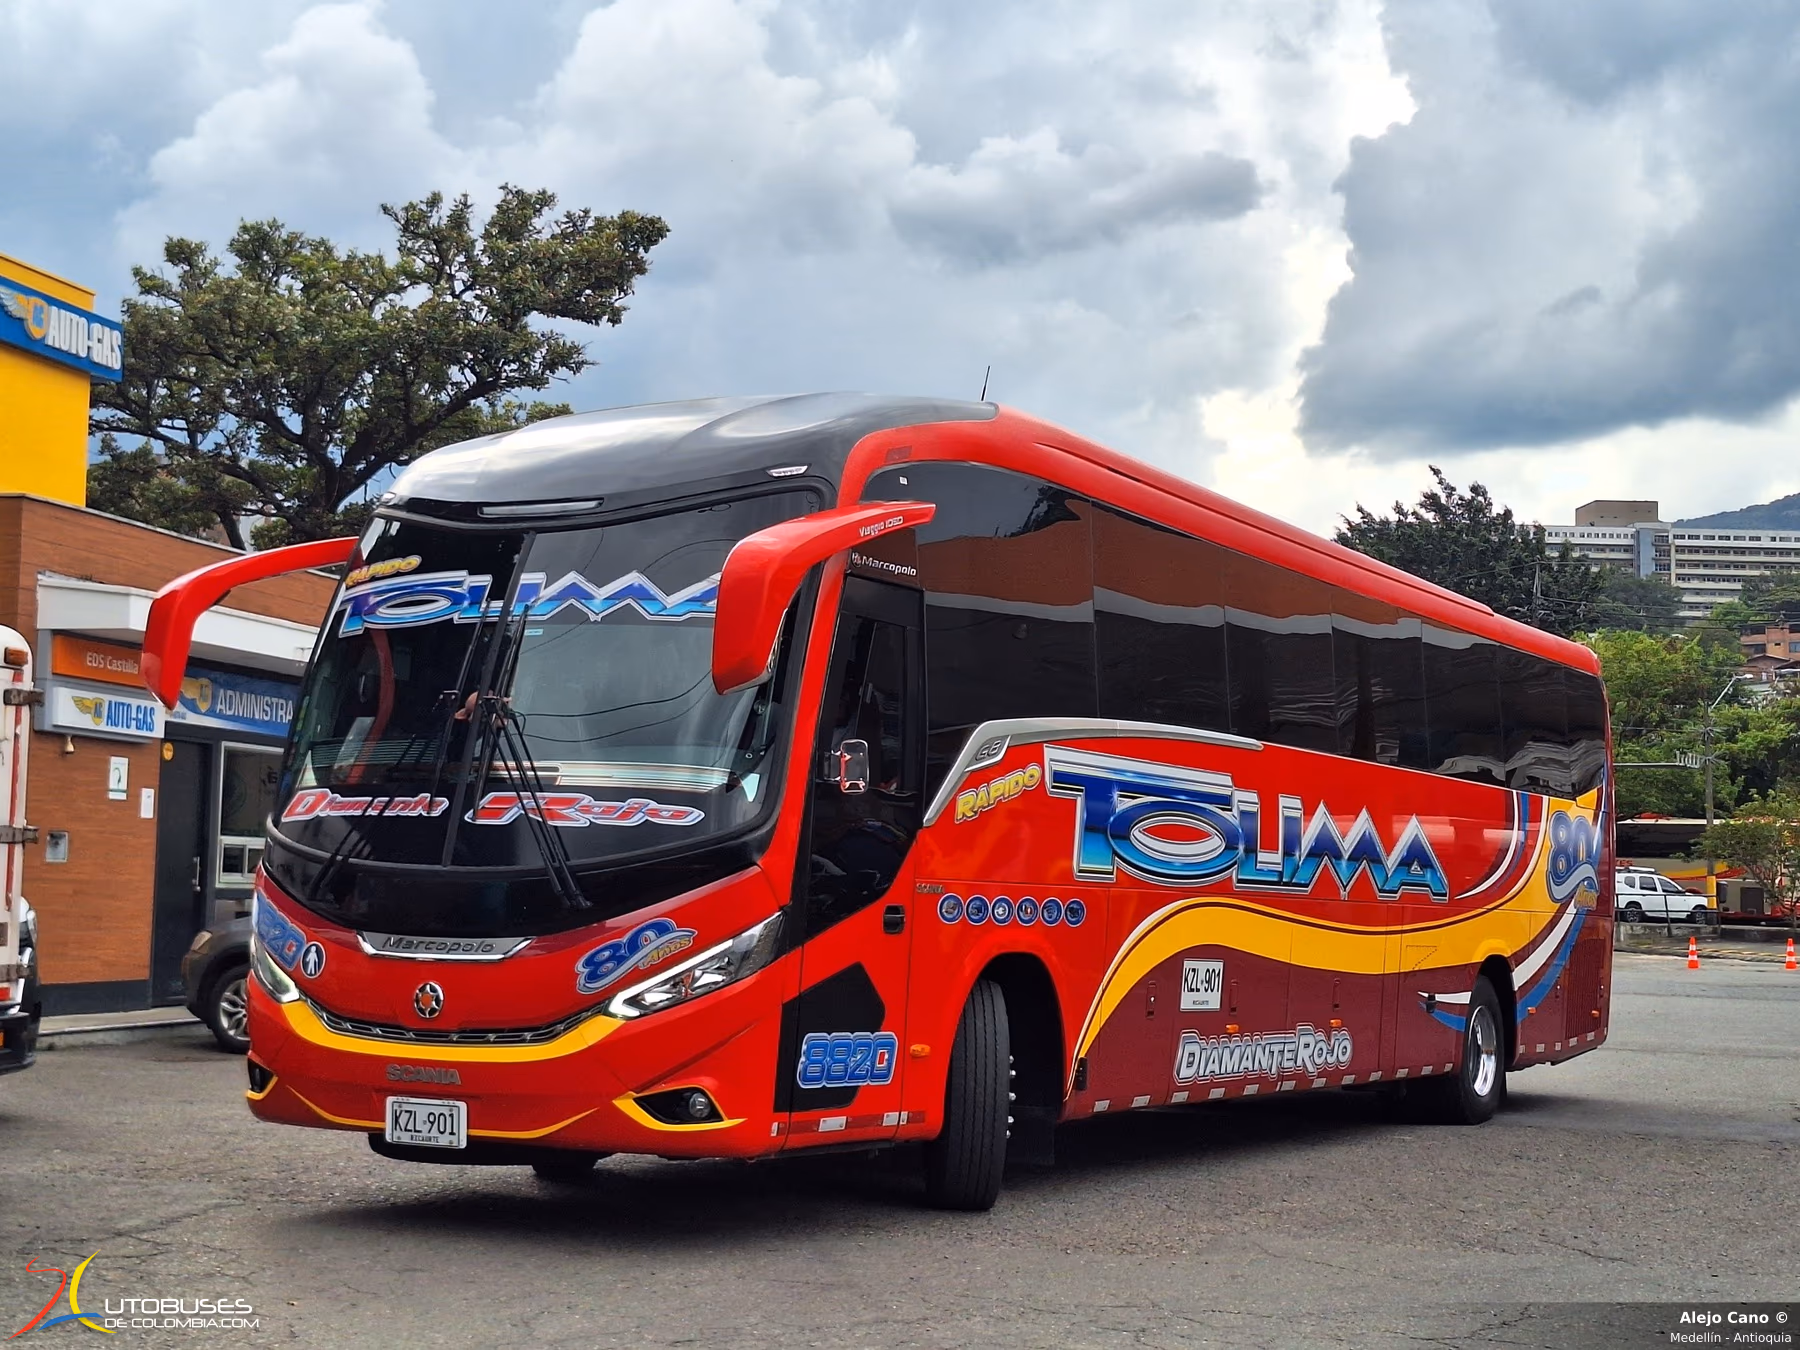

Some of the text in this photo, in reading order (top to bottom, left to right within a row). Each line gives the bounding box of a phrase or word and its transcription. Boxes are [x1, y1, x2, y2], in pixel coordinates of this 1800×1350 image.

[45, 306, 121, 370] AUTO-GAS
[859, 523, 884, 537] Viaggio
[862, 555, 917, 576] Marcopolo
[86, 652, 104, 668] EDS
[106, 700, 155, 732] AUTO-GAS
[975, 740, 1001, 761] G8
[954, 763, 1042, 824] RAPIDO
[1043, 743, 1450, 903] TOLIMA
[1548, 810, 1597, 888] 80
[382, 935, 495, 954] Marcopolo
[575, 917, 680, 993] 80
[386, 1063, 462, 1085] SCANIA
[797, 1031, 898, 1088] 8820
